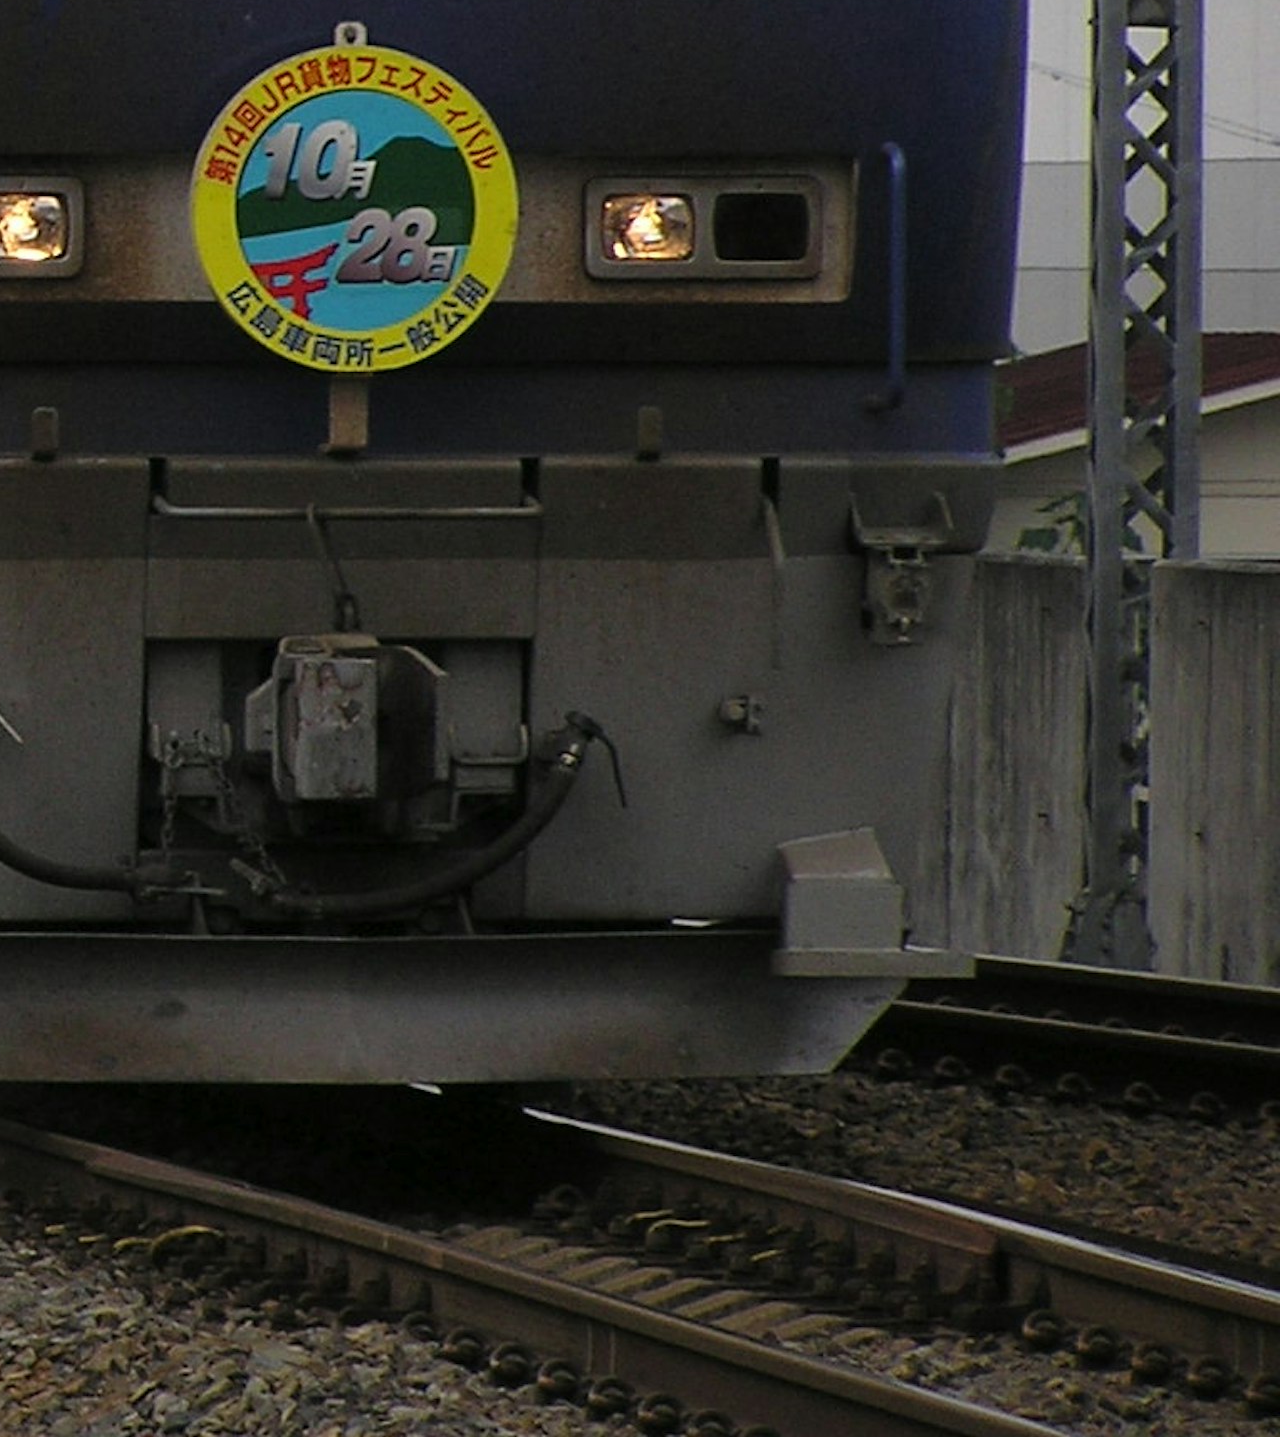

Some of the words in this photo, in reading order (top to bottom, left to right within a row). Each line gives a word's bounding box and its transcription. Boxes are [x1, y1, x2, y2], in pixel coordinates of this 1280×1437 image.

[204, 56, 500, 186] 第14回JR貨物フェスティバル
[264, 118, 377, 200] 10月
[336, 206, 456, 284] 28日
[226, 273, 490, 367] 広島車両所一般公開
